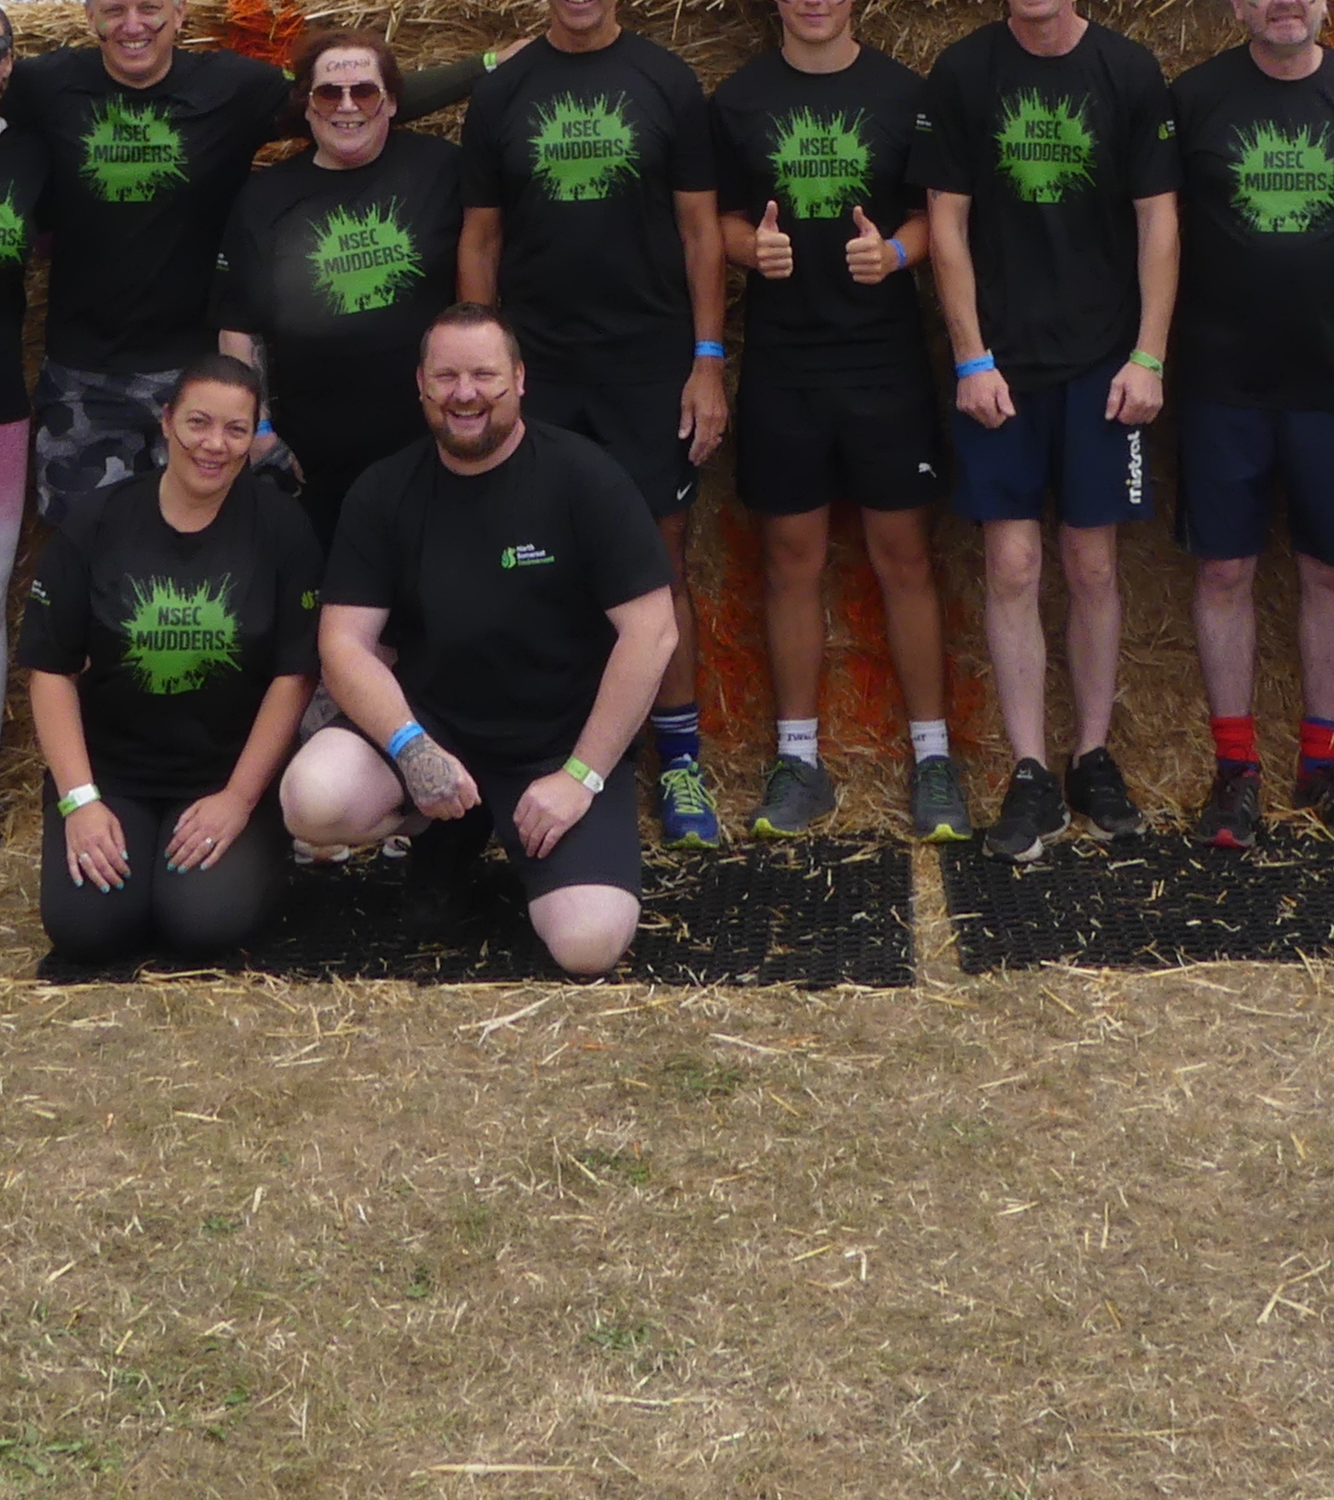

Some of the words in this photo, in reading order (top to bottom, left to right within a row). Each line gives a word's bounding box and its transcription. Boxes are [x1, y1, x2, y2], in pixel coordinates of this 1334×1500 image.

[112, 124, 150, 142] NSEC
[562, 119, 601, 138] NSEC
[1025, 120, 1062, 139] NSEC
[93, 144, 172, 163] MUDDERS
[544, 139, 623, 162] MUDDERS
[799, 137, 838, 156] NSEC
[1005, 142, 1082, 163] MUDDERS
[782, 159, 859, 178] MUDDERS
[1263, 151, 1304, 169] NSEC
[1244, 173, 1327, 192] MUDDERS
[338, 228, 379, 251] NSEC
[323, 244, 404, 275] MUDDERS
[1125, 430, 1142, 504] mistral
[158, 606, 202, 626] NSEC
[136, 630, 226, 651] MUDDERS
